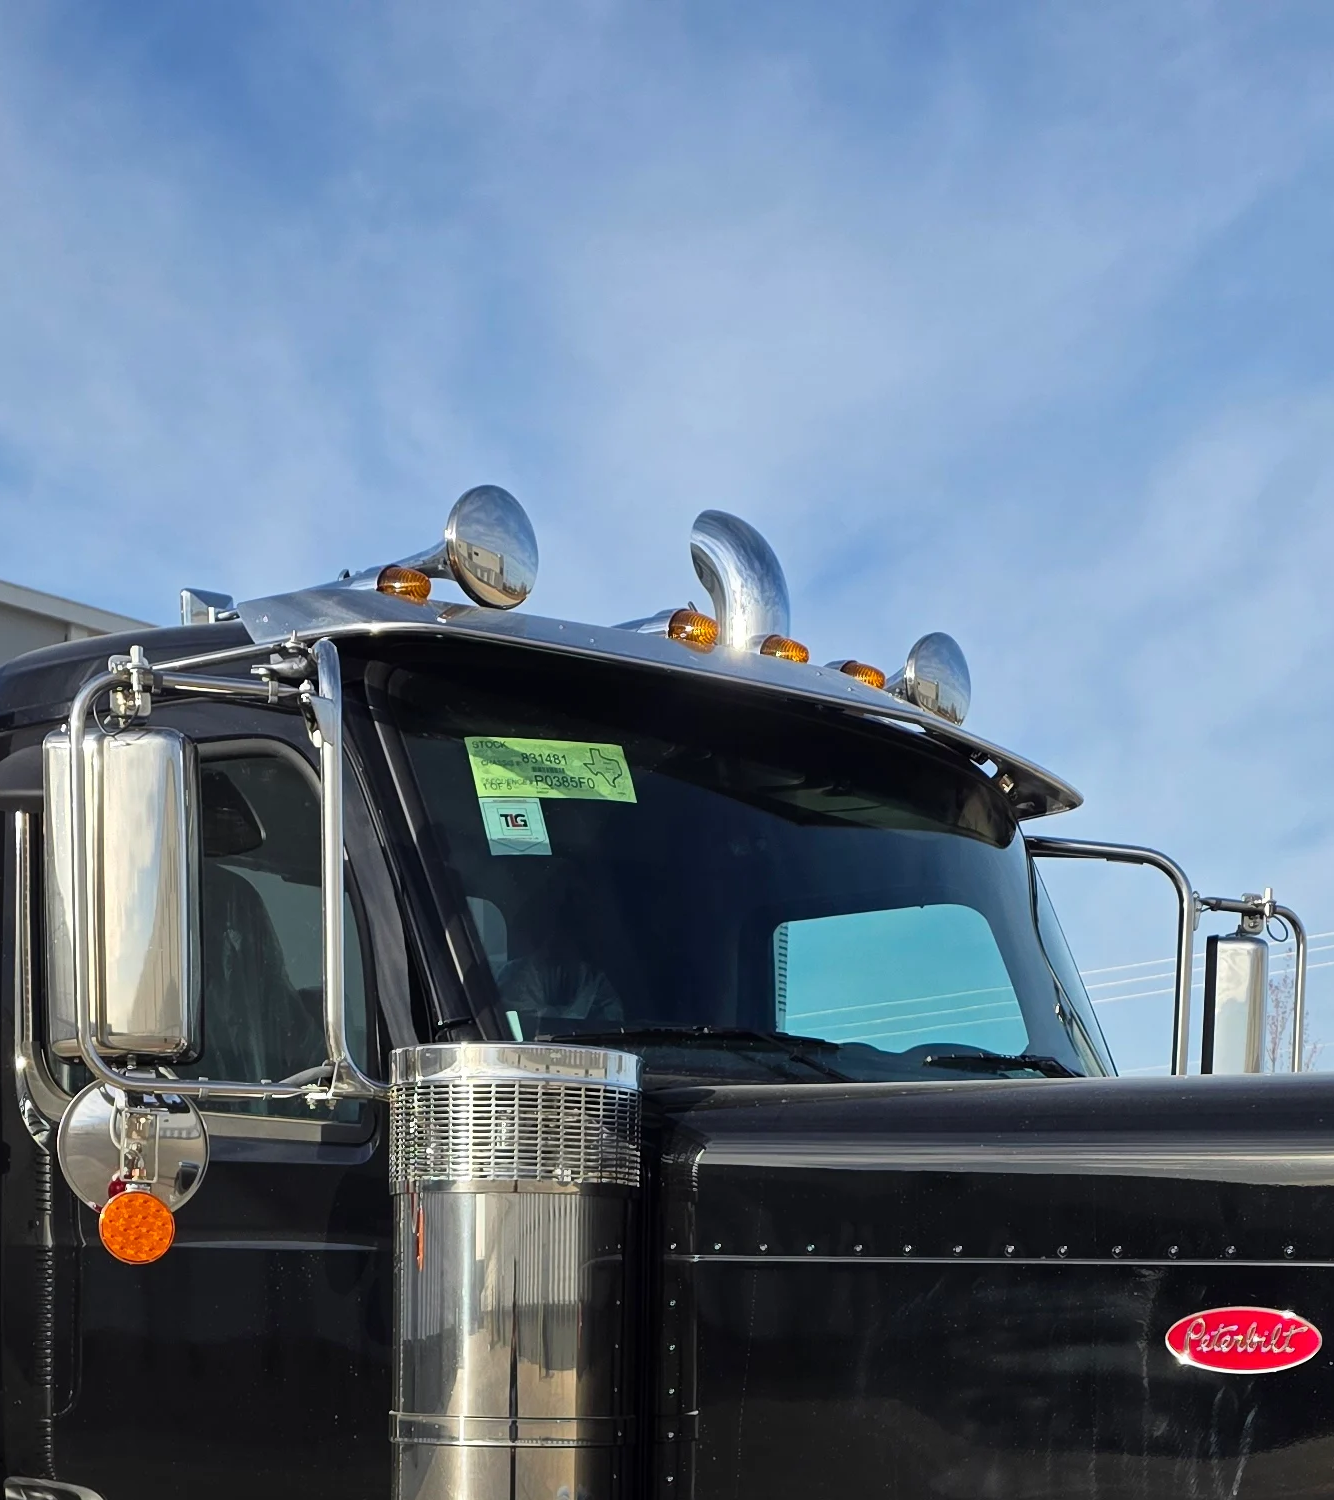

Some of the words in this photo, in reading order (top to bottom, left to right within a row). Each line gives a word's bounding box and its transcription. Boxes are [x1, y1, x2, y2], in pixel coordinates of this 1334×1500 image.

[471, 740, 508, 750] STOCK
[520, 752, 569, 766] 831481
[534, 774, 597, 790] P0385F0
[499, 813, 529, 828] TLG
[1181, 1317, 1310, 1355] Peterbilt
